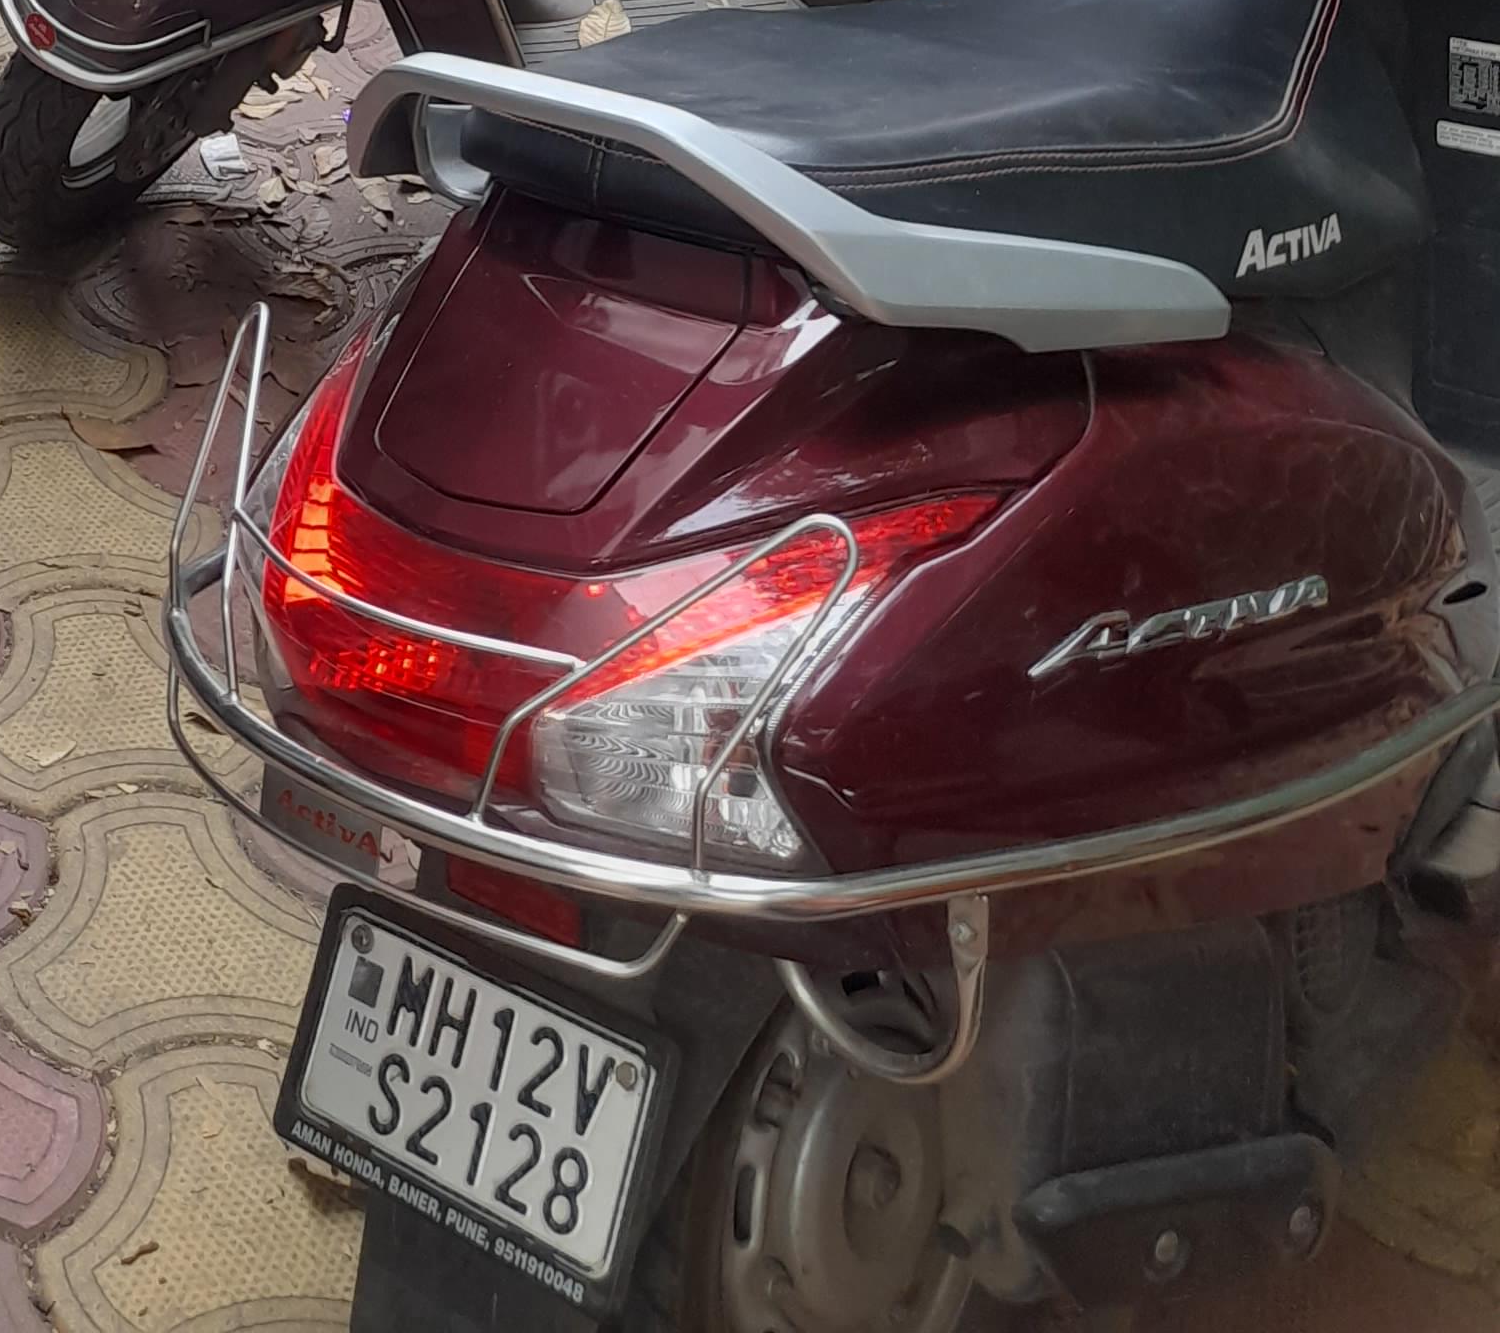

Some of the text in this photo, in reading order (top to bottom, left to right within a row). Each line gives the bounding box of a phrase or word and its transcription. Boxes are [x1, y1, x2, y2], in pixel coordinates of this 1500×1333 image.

[344, 1009, 380, 1044] IND
[386, 955, 616, 1136] MH12V
[290, 1120, 585, 1303] AMAN HONDA, BANER, PUNE, 9511910048
[367, 1052, 589, 1236] S2128
